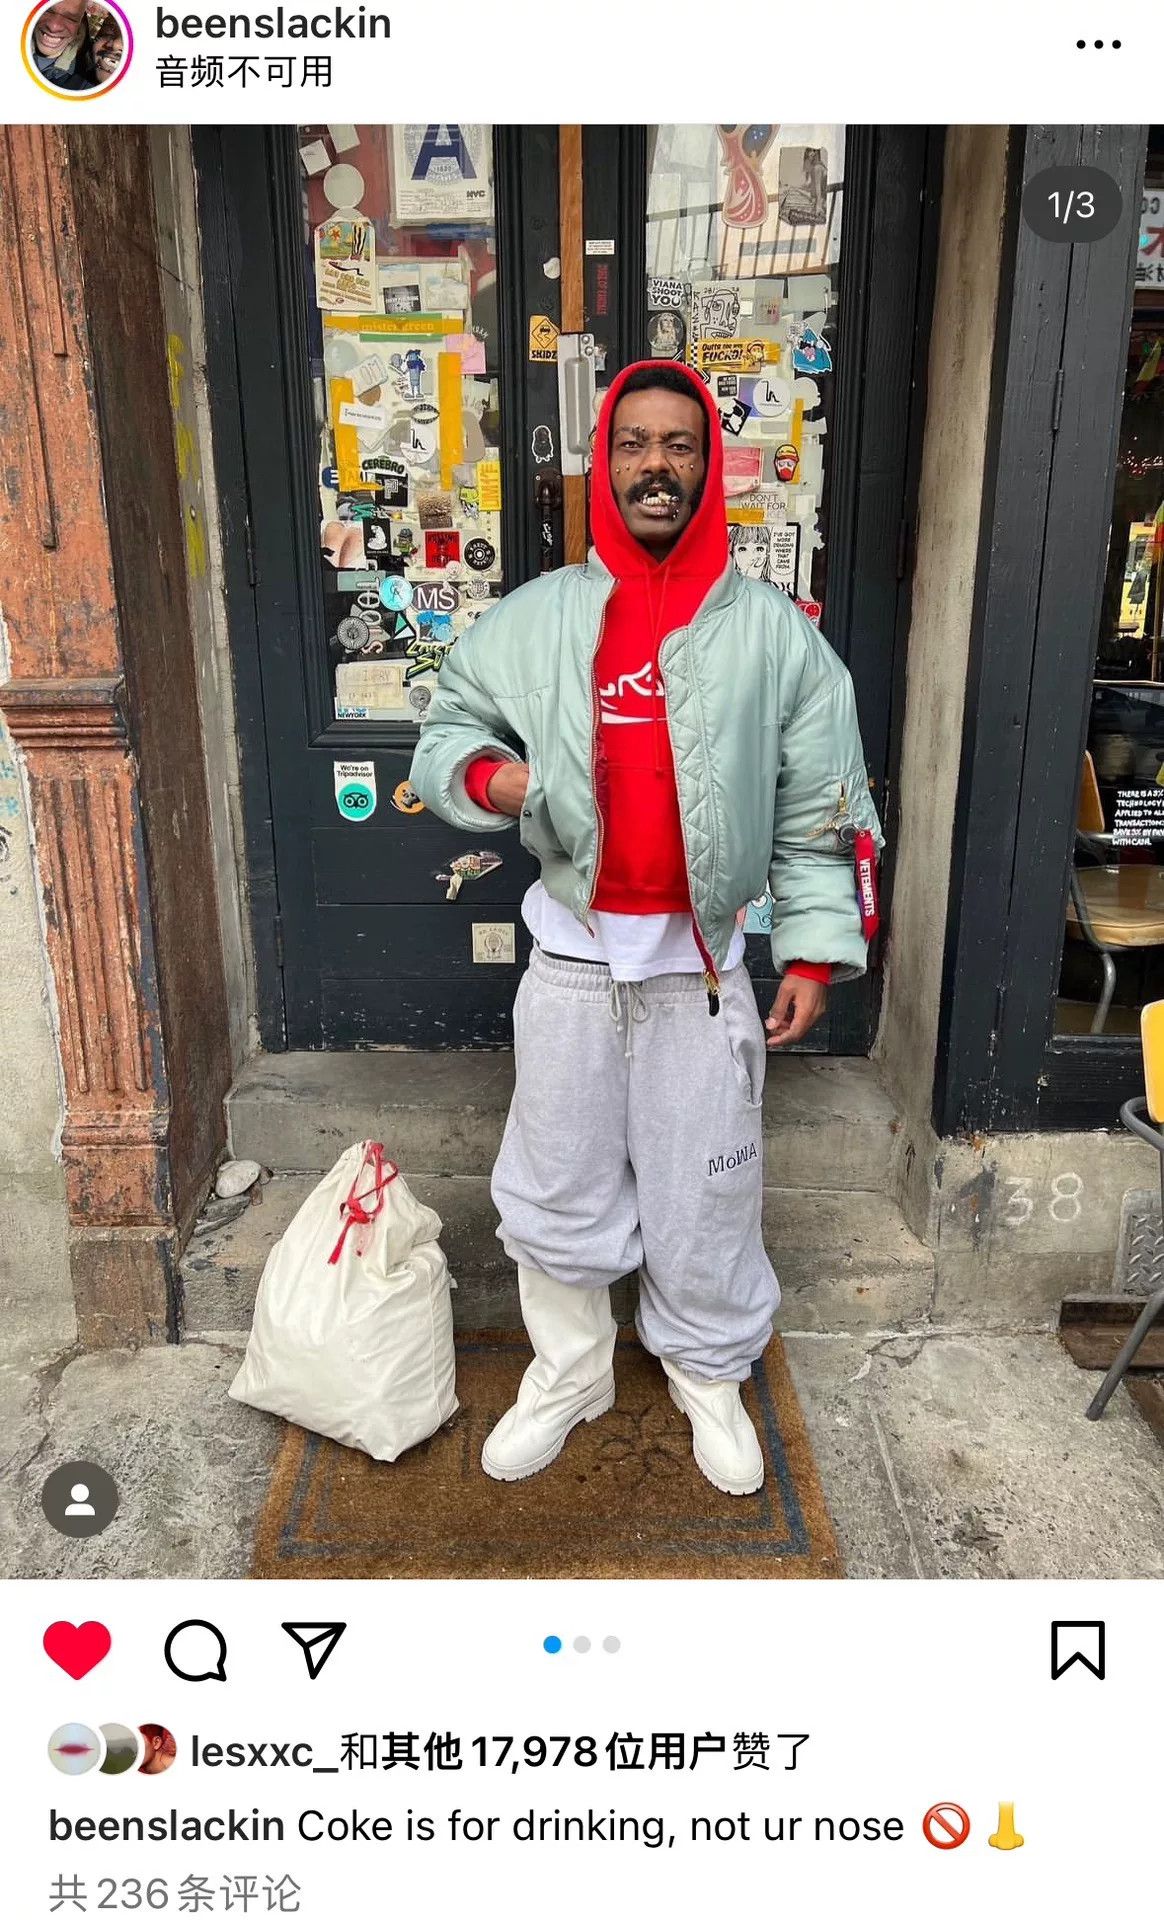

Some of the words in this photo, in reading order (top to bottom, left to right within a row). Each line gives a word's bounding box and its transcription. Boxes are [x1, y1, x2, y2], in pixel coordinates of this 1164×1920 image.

[411, 124, 477, 180] A
[652, 287, 682, 296] SHOOT
[653, 280, 683, 290] VIANA
[652, 295, 681, 307] YOU
[361, 459, 406, 475] CEREBRO
[767, 502, 786, 510] FOR
[417, 588, 455, 610] MS
[337, 770, 373, 778] Tripadvisor
[859, 857, 876, 918] VETEMENTS
[707, 1142, 758, 1177] MoWA
[1003, 1172, 1084, 1226] 38
